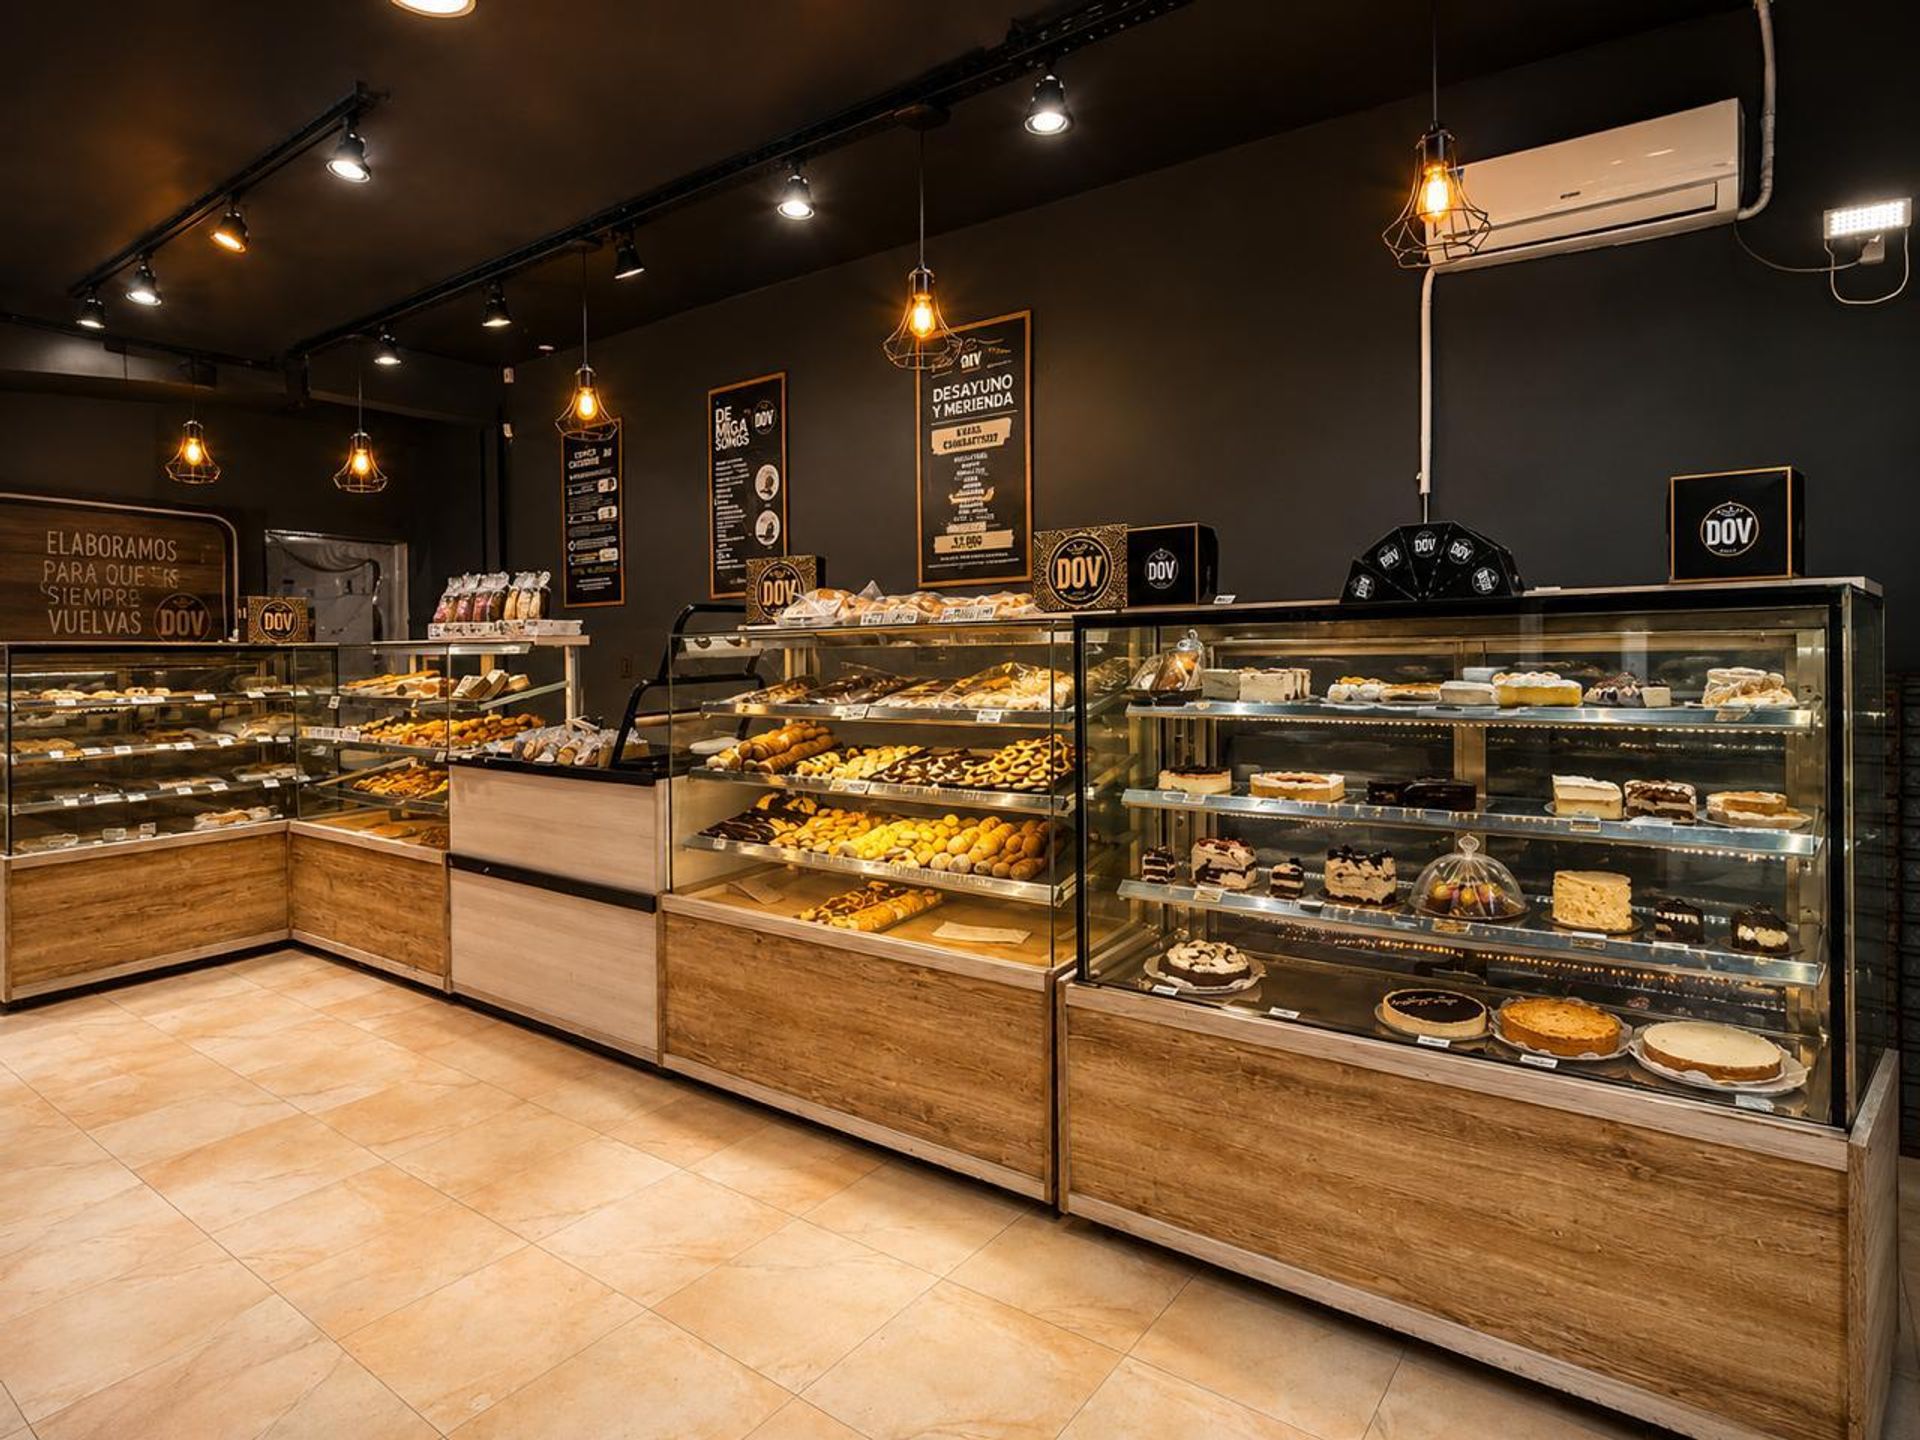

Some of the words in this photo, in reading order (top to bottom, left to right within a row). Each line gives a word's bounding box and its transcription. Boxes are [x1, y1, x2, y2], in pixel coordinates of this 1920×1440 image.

[932, 373, 1013, 403] DESAYUNO
[715, 405, 732, 423] DE
[932, 405, 942, 418] Y
[944, 391, 1014, 417] MERIENDA
[754, 409, 774, 428] DOV
[1413, 537, 1437, 553] DOV
[1705, 517, 1753, 546] DOV
[47, 530, 178, 562] ELABORAMOS
[43, 559, 98, 584] PARA
[106, 563, 146, 587] QUE
[1056, 554, 1103, 590] DOV
[1148, 560, 1176, 580] DOV
[763, 579, 797, 607] DOV
[47, 609, 142, 635] VUELVAS
[160, 608, 205, 637] DOV
[263, 611, 294, 632] DOV
